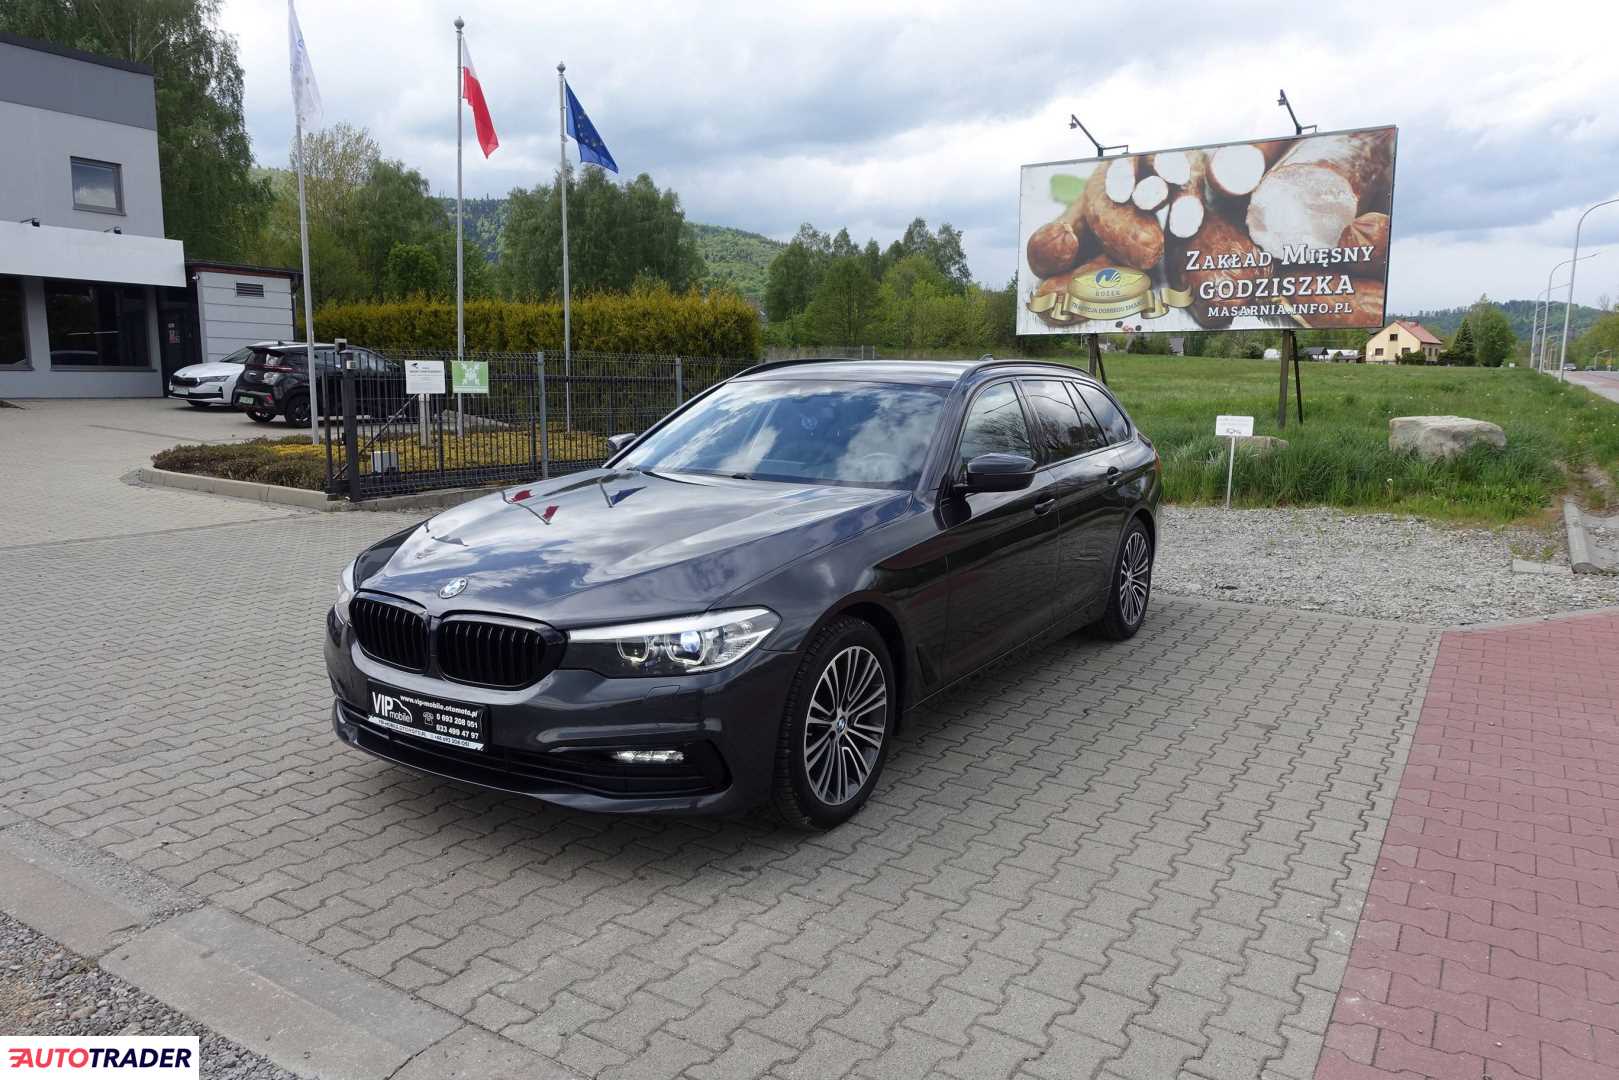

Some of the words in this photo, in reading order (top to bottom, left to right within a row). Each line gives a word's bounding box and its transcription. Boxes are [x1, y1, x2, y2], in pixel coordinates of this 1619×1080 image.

[1186, 250, 1273, 271] ZAKŁAD
[1282, 243, 1375, 268] MIĘSNY
[1199, 275, 1355, 300] GODZISZKA
[1207, 302, 1353, 318] MASARNIA.INFO.PL
[372, 691, 394, 717] VIP
[400, 695, 478, 718] www.vip-mobile.otomoto.pl
[389, 711, 411, 723] mobile
[461, 729, 470, 738] 47
[471, 732, 479, 740] 97
